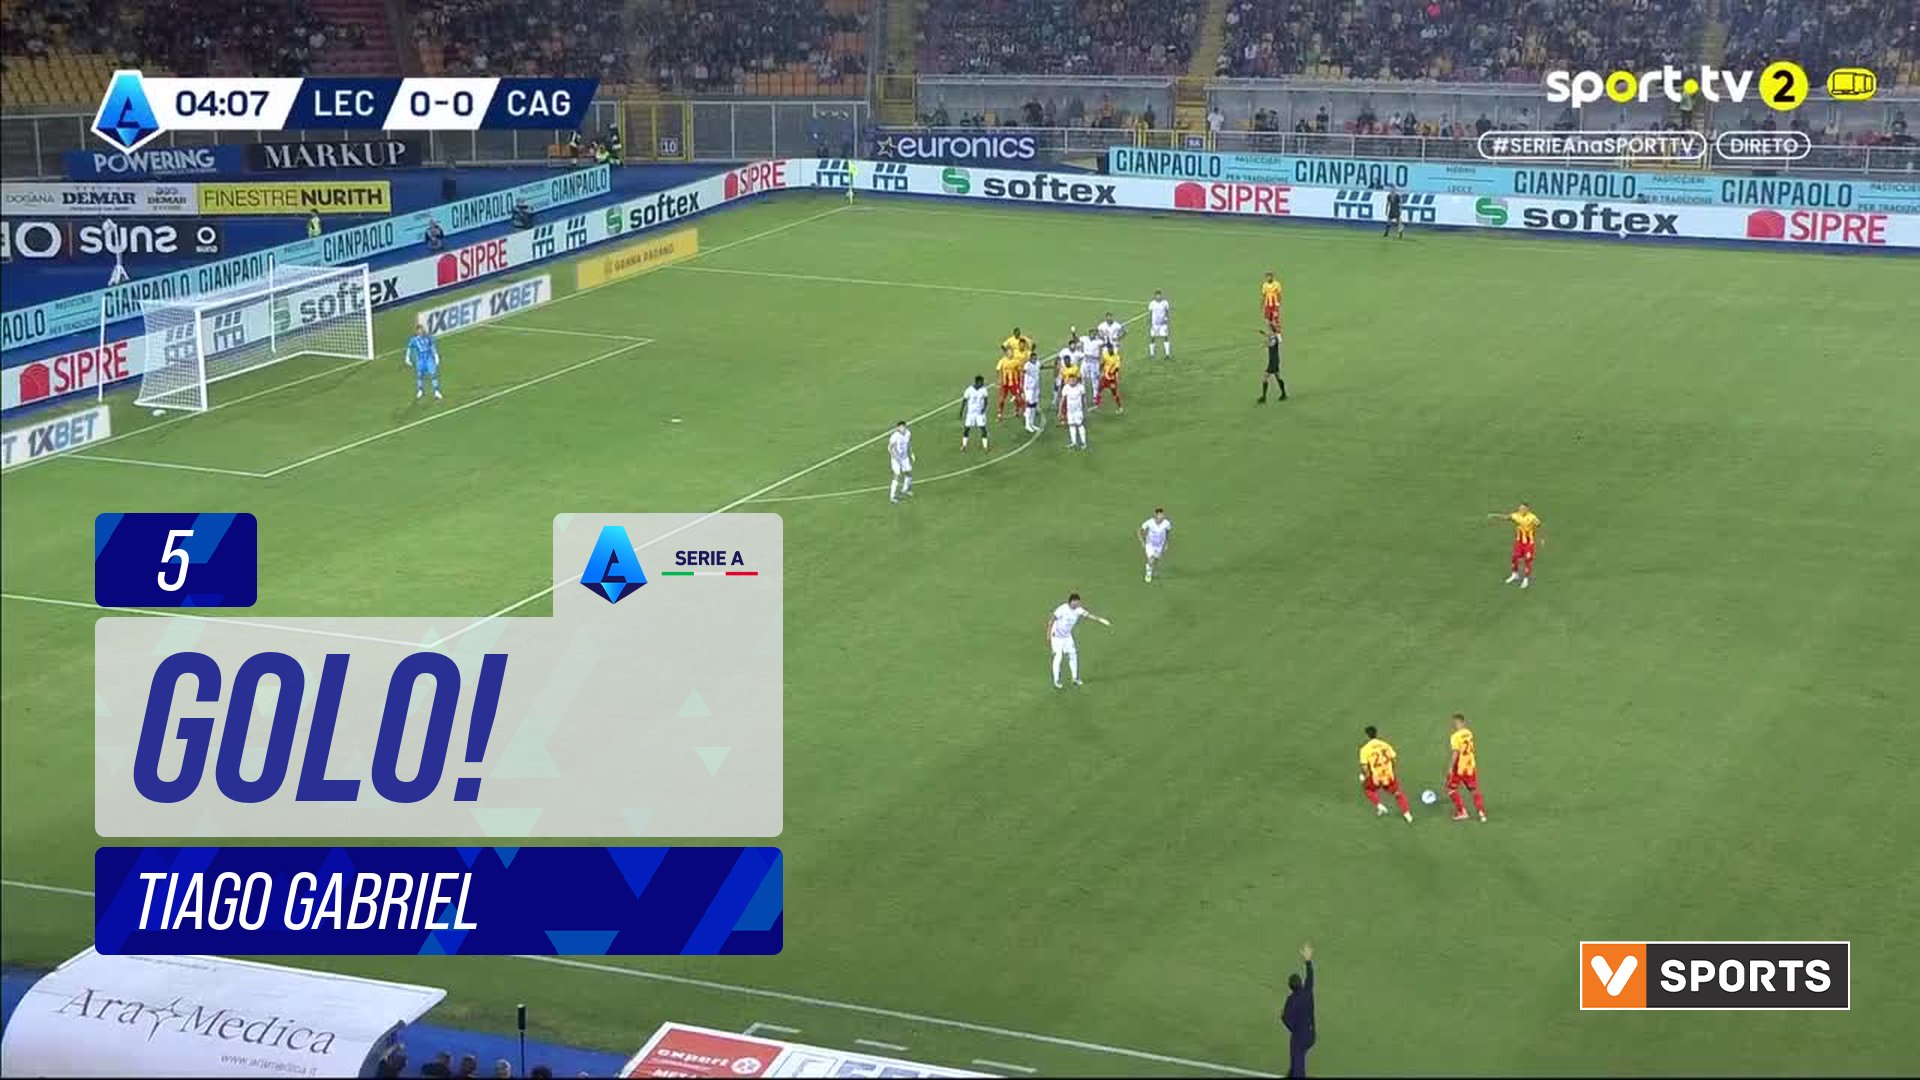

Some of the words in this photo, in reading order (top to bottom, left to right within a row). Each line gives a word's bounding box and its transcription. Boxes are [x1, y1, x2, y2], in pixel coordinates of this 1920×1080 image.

[93, 150, 215, 174] POWERING
[264, 141, 406, 170] MARKUP
[897, 135, 1036, 160] euronics
[740, 161, 786, 194] SIPRE
[1116, 150, 1221, 178] GIANPAOLO
[1295, 160, 1408, 188] GIANPAOLO
[62, 190, 136, 205] DEMAR
[203, 189, 299, 207] FINESTRE
[301, 187, 383, 206] NURITH
[552, 168, 607, 201] GIANPAOLO
[983, 174, 1116, 205] softex
[1210, 183, 1291, 214] SIPRE
[1514, 170, 1636, 199] GIANPAOLO
[1722, 178, 1852, 208] GIANPAOLO
[451, 192, 514, 229] GIANPAOLO
[629, 191, 700, 229] softex
[1522, 203, 1679, 235] softex
[323, 221, 394, 263] GIANPAOLO
[1791, 210, 1888, 244] SIPRE
[460, 238, 508, 279] SIPRE
[300, 276, 399, 323] softex
[427, 298, 482, 335] 1XBET
[490, 280, 543, 316] 1XBET
[54, 341, 129, 393] SIPRE
[28, 411, 98, 456] 1XBET
[52, 987, 144, 1026] Ara
[180, 1005, 337, 1055] Medica
